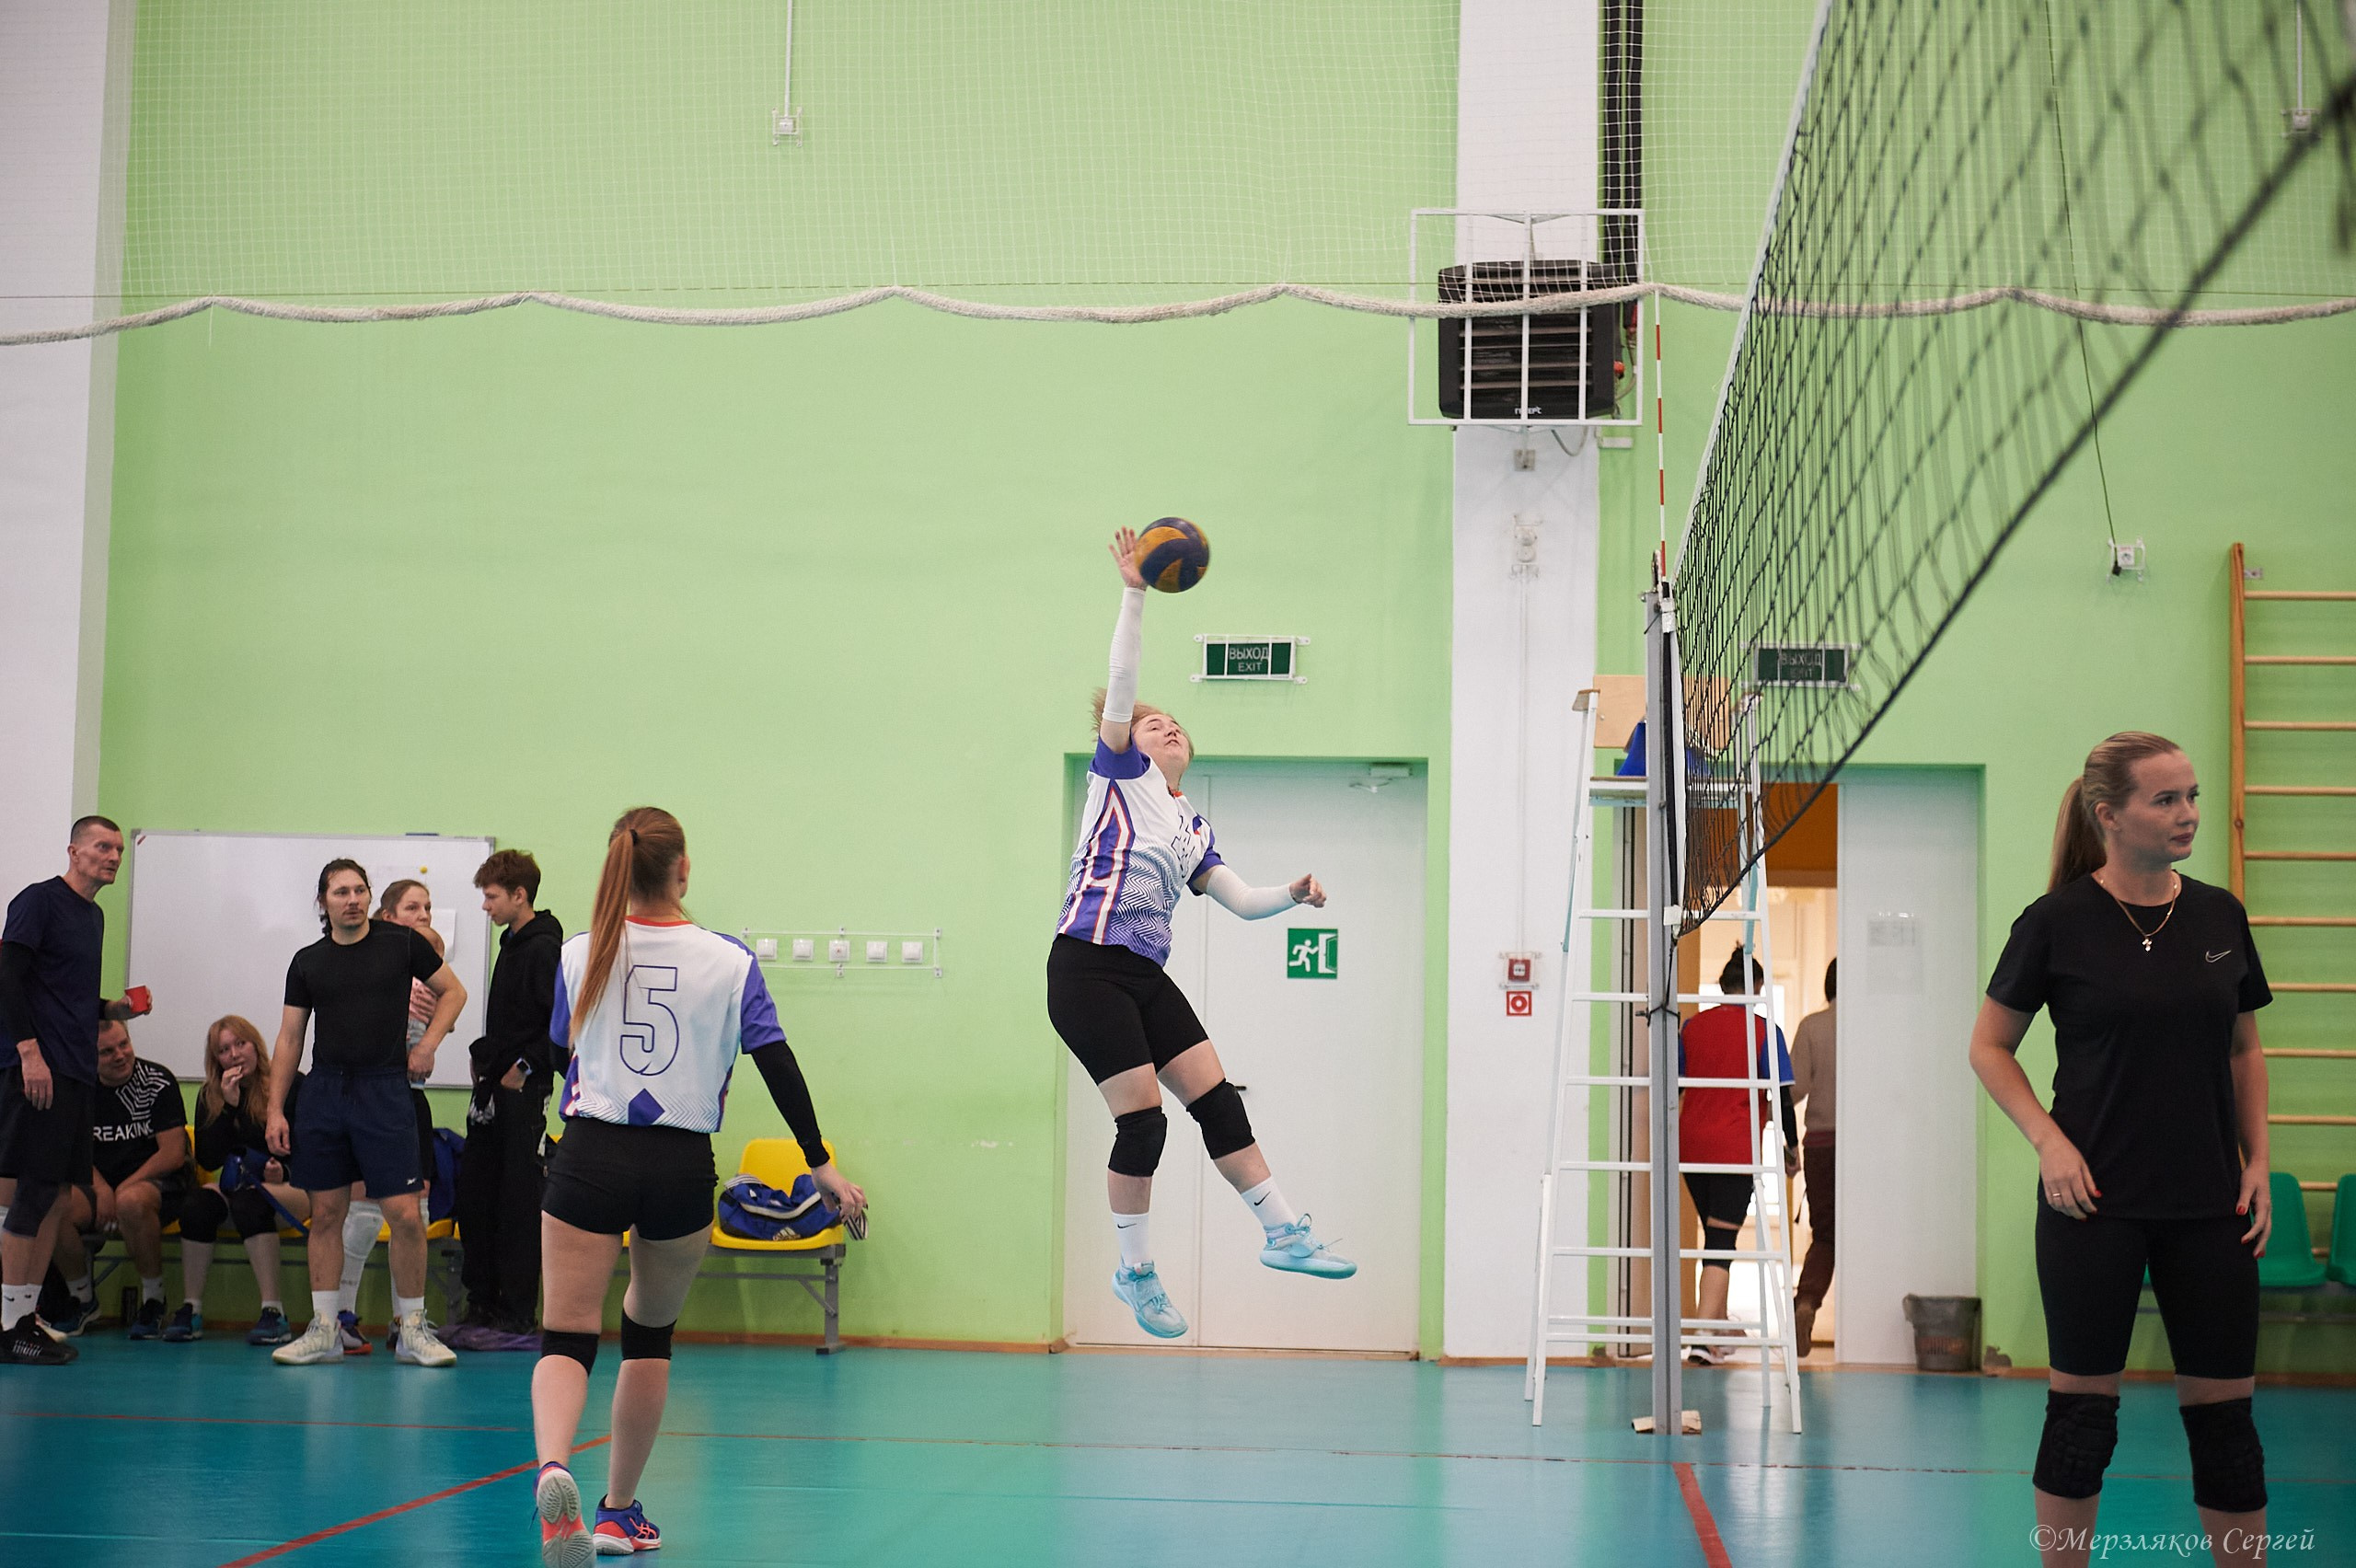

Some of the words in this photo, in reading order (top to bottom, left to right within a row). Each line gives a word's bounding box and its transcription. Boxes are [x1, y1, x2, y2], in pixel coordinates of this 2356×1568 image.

[1229, 647, 1269, 661] ВЫХОД
[1238, 662, 1262, 672] EXIT
[620, 964, 680, 1077] 5
